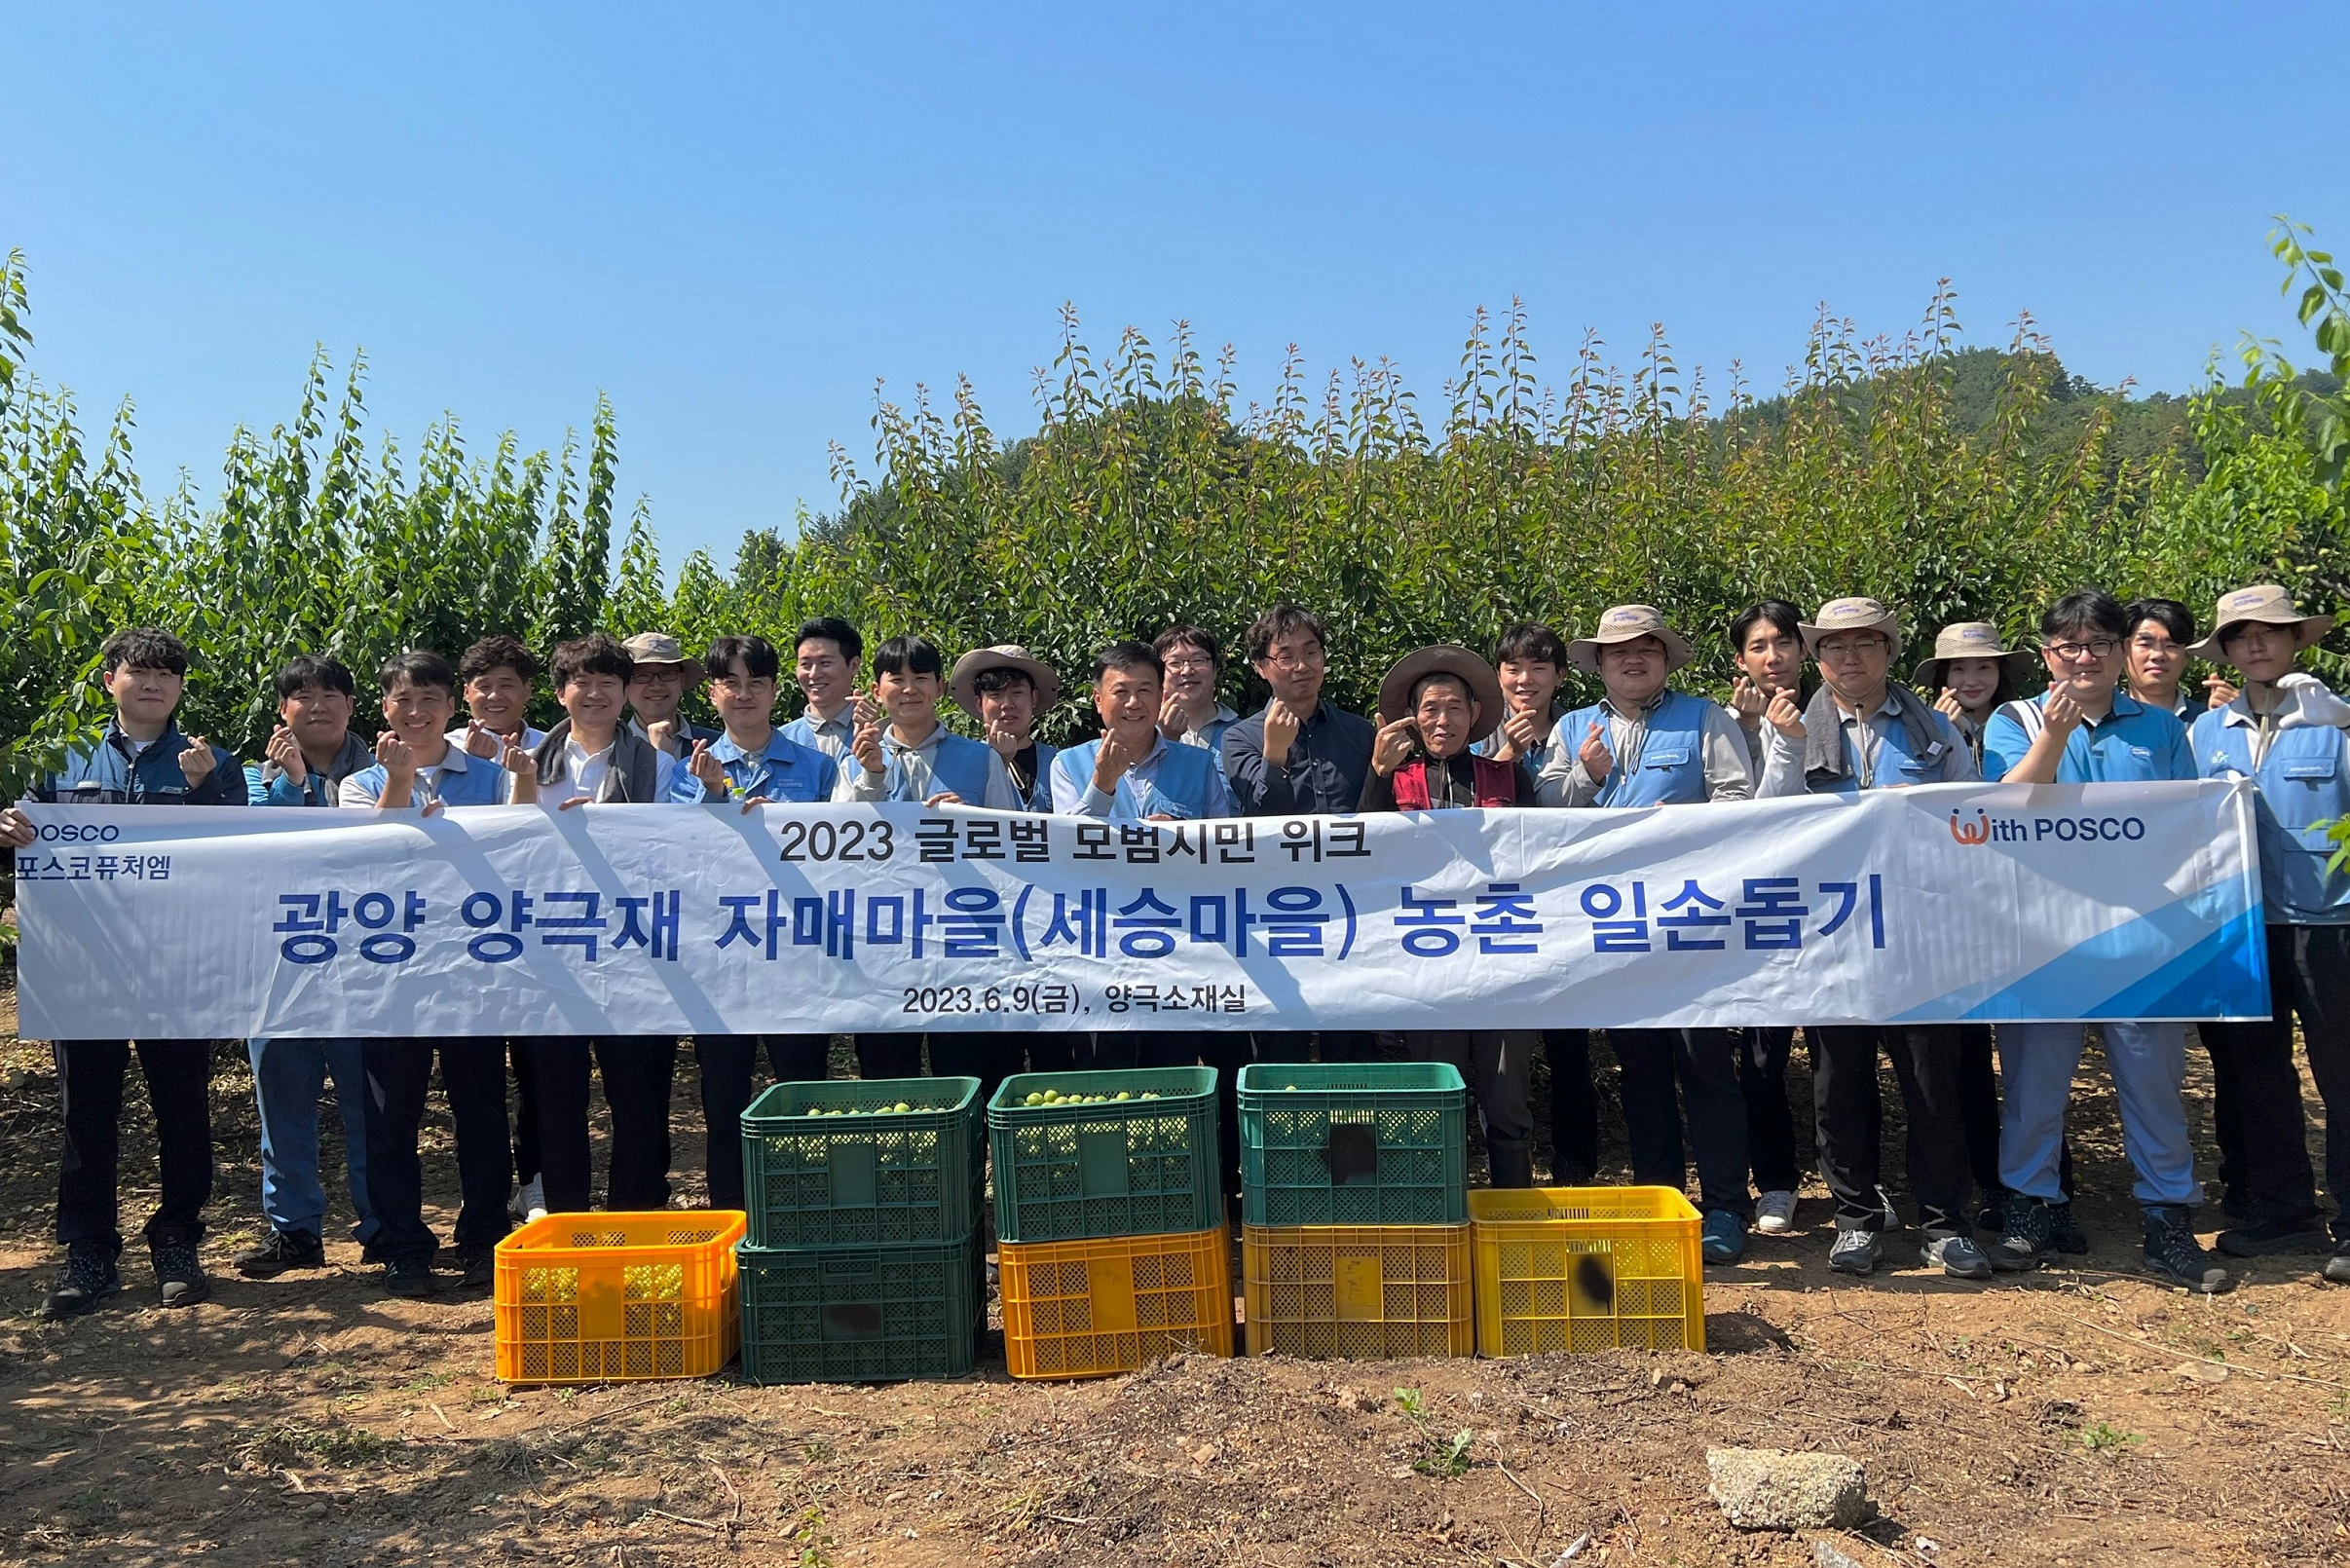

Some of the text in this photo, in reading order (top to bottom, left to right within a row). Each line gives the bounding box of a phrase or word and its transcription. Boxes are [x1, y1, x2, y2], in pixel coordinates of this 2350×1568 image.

[781, 819, 1371, 865] 2023 글로벌 모범시민 위크
[1951, 808, 2145, 845] With POSCO
[17, 855, 171, 880] 포스코퓨처엠
[274, 875, 1885, 965] 광양 양극재 자매마을(세승마을) 농촌 일손돕기
[904, 985, 1247, 1016] 2023.6.9(금), 양극소재실
